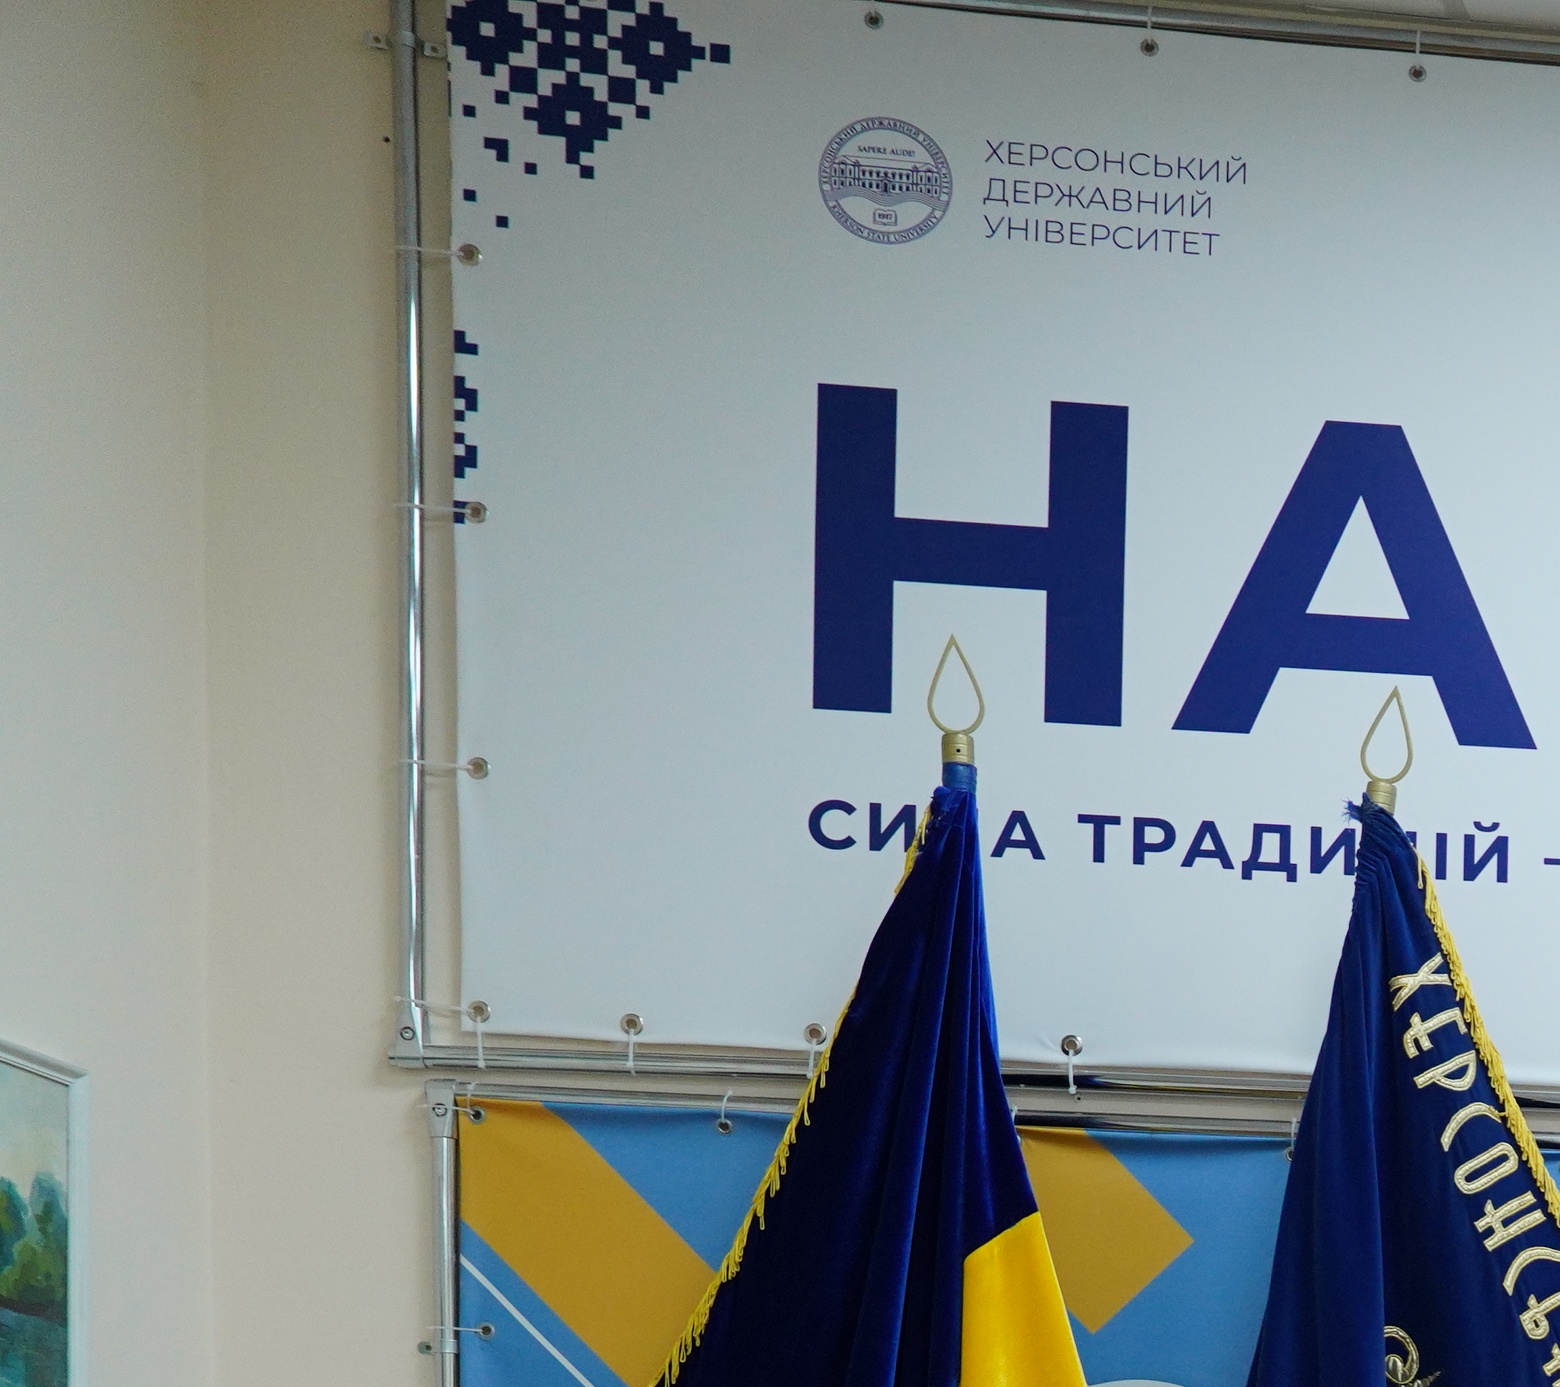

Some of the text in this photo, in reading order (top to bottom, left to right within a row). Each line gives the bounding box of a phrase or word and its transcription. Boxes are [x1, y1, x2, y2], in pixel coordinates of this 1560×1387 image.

[857, 145, 887, 155] SAPERE
[984, 138, 1249, 187] ХЕРСОНСЬКИЙ
[983, 177, 1214, 221] ДЕРЖАВНИЙ
[984, 214, 1221, 257] УНІВЕРСИТЕТ
[808, 799, 1046, 861] СИА
[1077, 813, 1510, 884] ТРАДИІЙ
